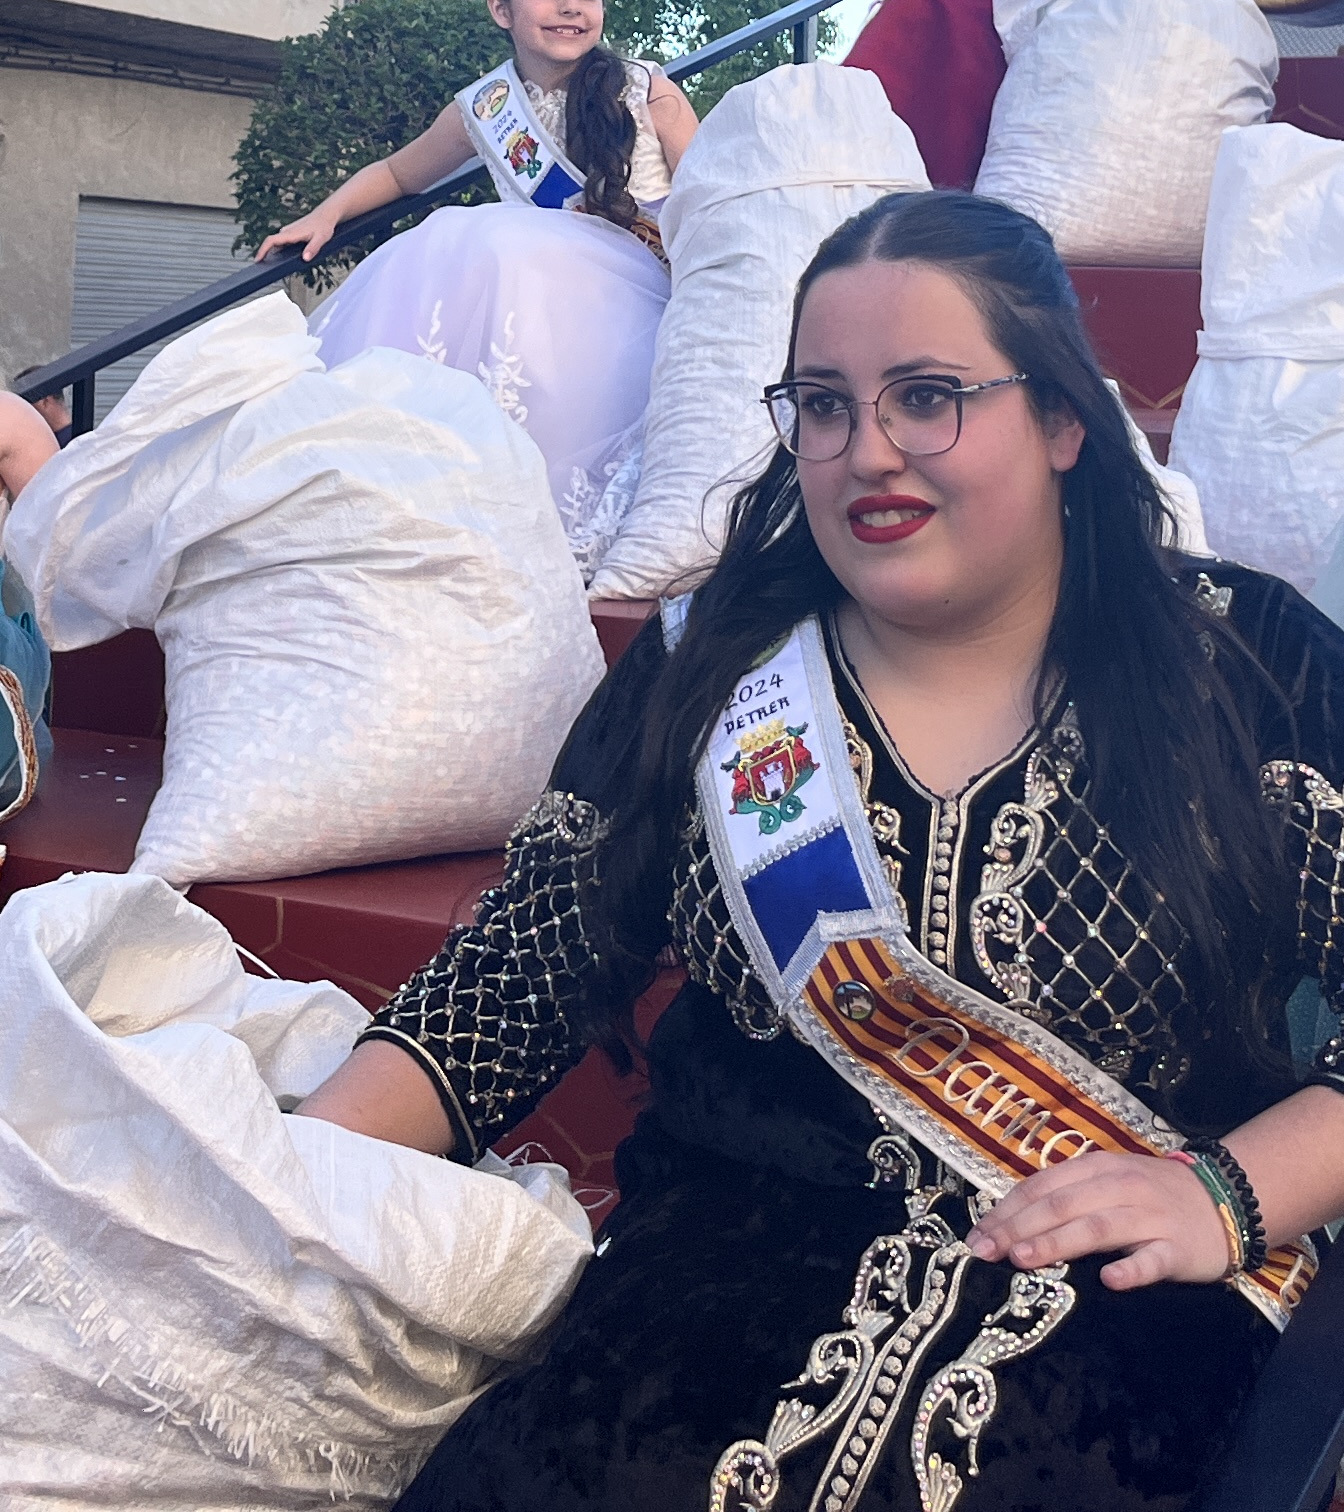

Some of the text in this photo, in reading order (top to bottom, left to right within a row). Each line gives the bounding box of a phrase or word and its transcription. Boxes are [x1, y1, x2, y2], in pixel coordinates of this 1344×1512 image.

[492, 109, 513, 135] 2024
[724, 672, 784, 710] 2024
[724, 696, 791, 735] PETRER
[885, 1016, 1095, 1170] Dama
